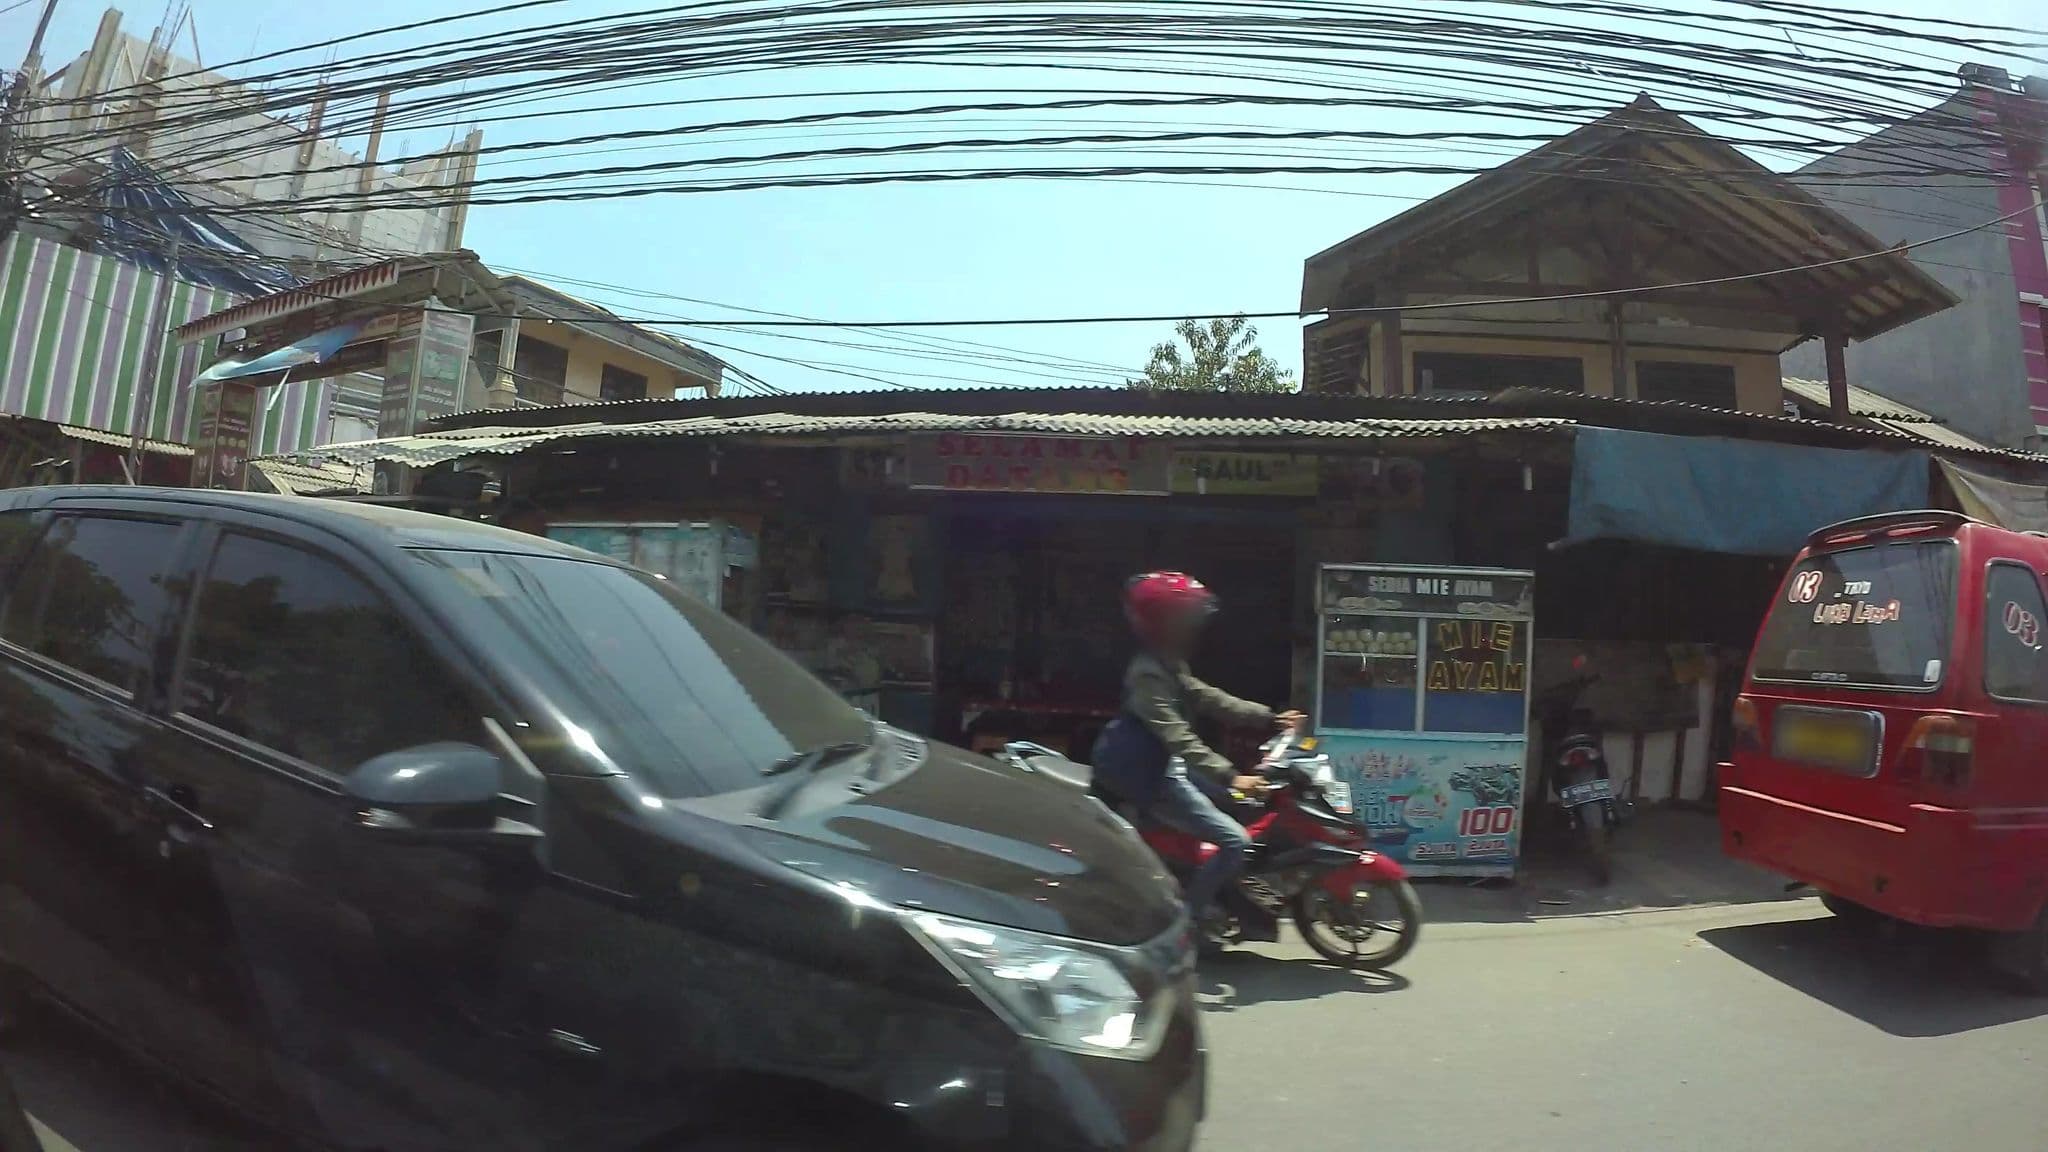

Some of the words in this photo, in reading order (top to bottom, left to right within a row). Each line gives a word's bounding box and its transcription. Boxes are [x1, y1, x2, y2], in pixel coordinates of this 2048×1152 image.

[1416, 578, 1449, 596] MIE
[1437, 620, 1515, 652] MIE
[1427, 661, 1525, 692] AYAM
[1459, 805, 1515, 837] 100
